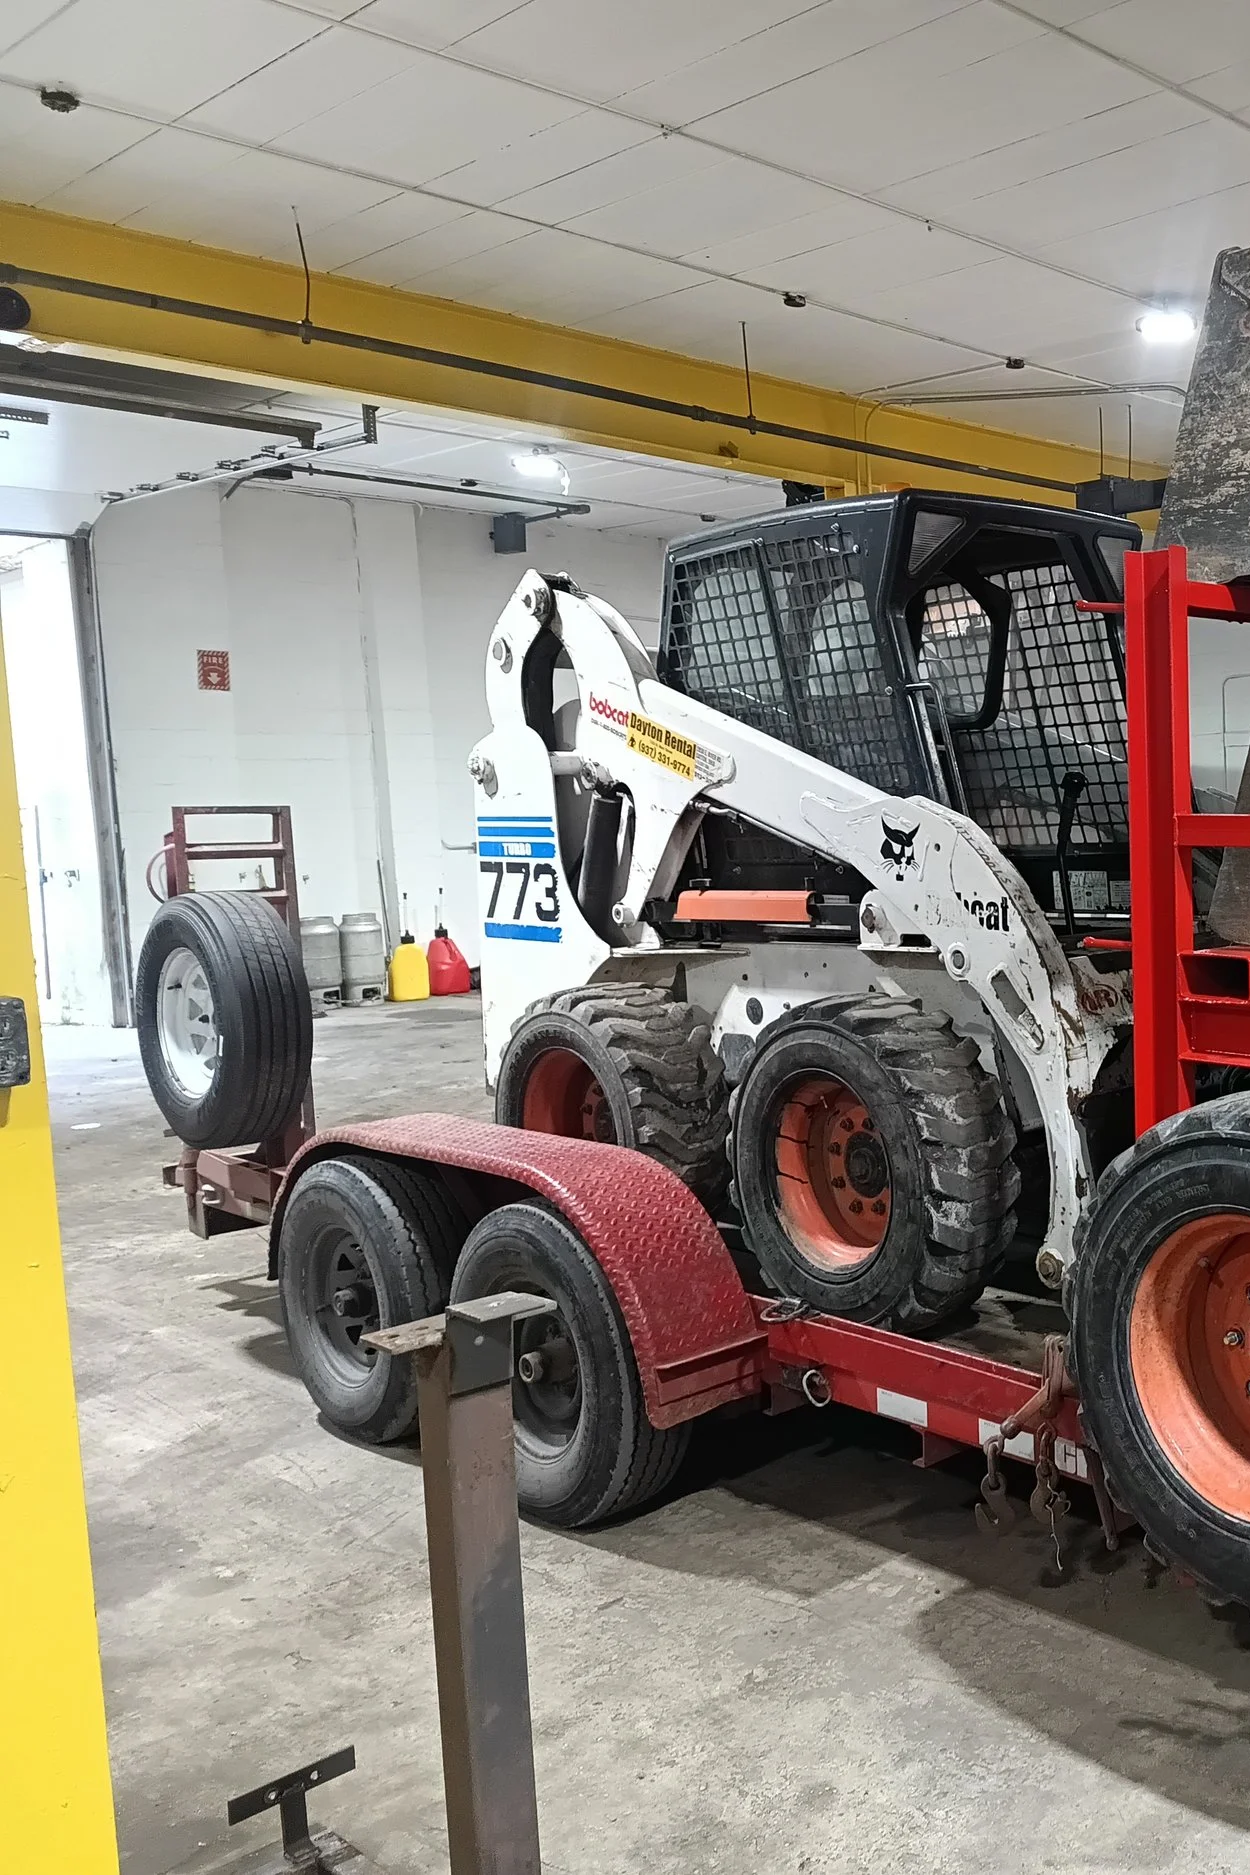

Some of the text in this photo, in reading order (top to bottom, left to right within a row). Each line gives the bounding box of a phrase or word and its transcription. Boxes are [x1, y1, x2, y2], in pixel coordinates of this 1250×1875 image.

[203, 656, 224, 664] FIRE
[589, 692, 629, 727] bobcat
[630, 713, 664, 742] Dayton
[664, 730, 697, 760] Rental
[638, 739, 657, 759] (937)
[657, 751, 691, 777] 331-9774
[479, 861, 561, 922] 773
